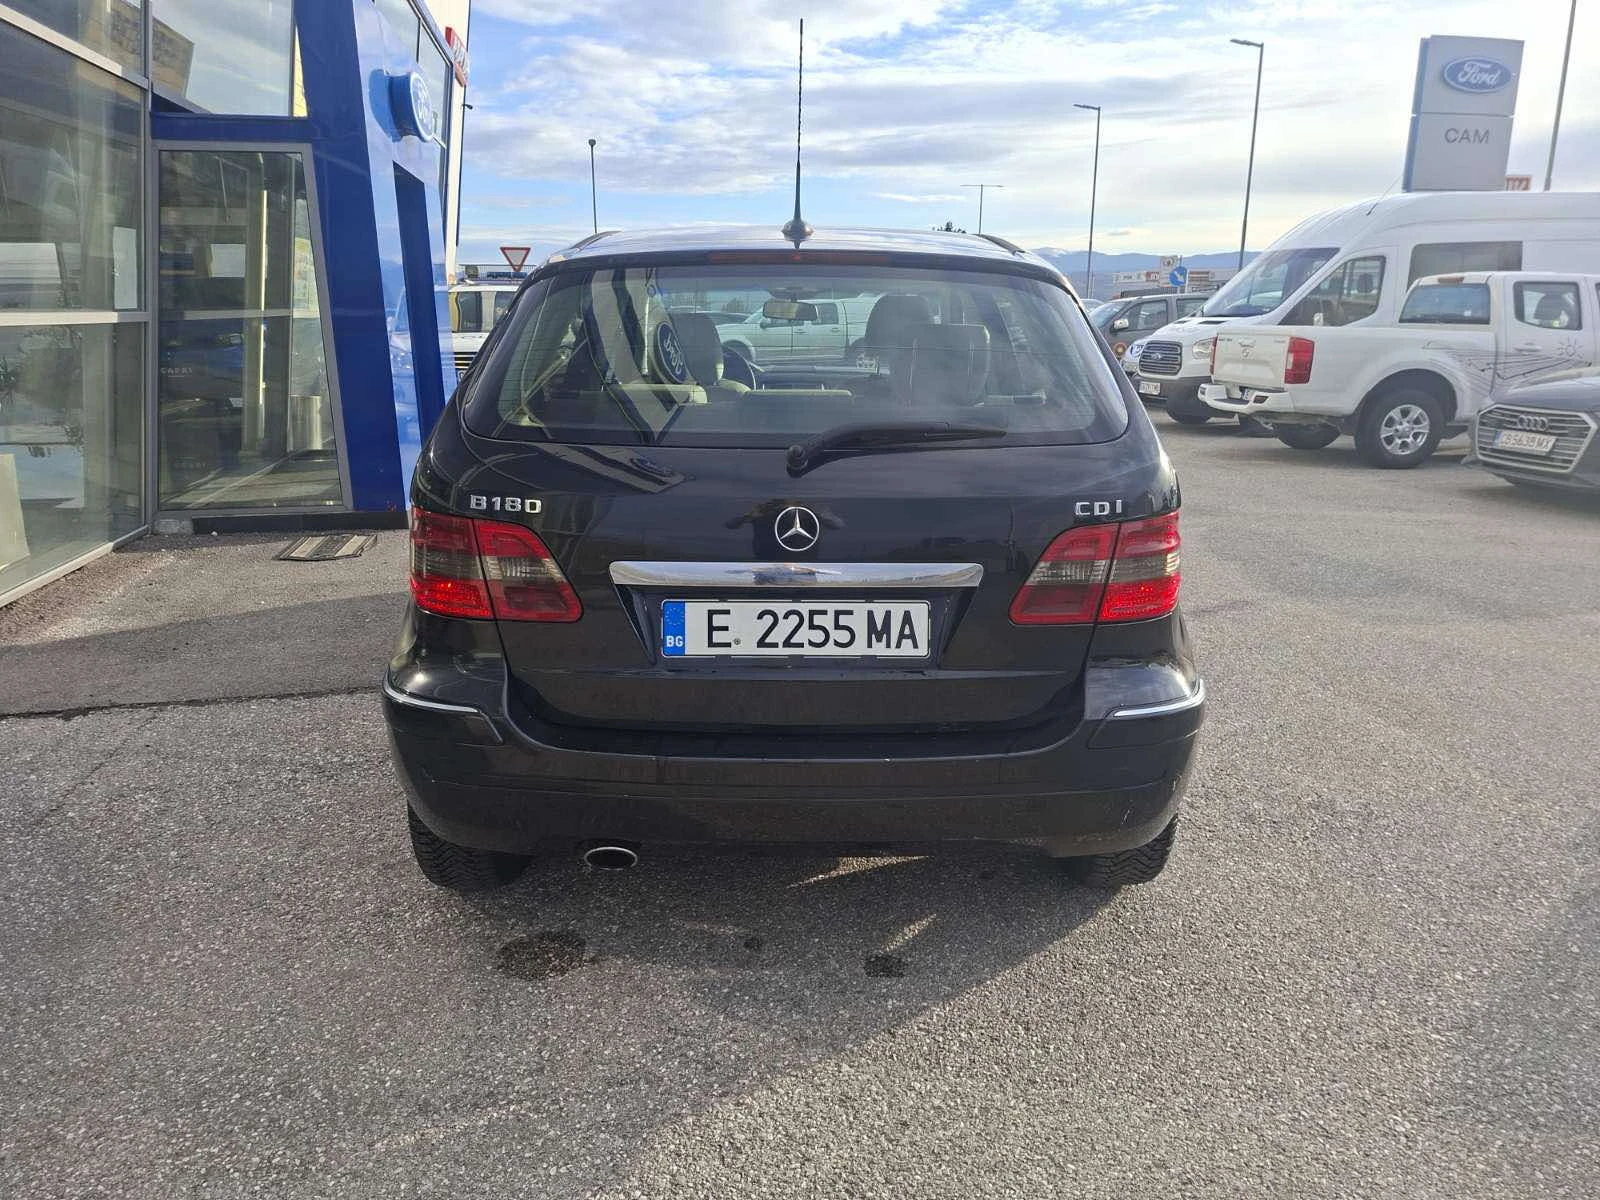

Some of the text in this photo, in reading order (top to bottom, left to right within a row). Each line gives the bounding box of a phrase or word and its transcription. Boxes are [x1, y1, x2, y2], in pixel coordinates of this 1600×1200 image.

[1457, 61, 1501, 85] Ford
[1444, 128, 1490, 144] CAM
[470, 494, 542, 513] B180
[1075, 500, 1122, 516] CDI
[707, 609, 919, 648] E 2255 MA
[666, 635, 683, 647] BG
